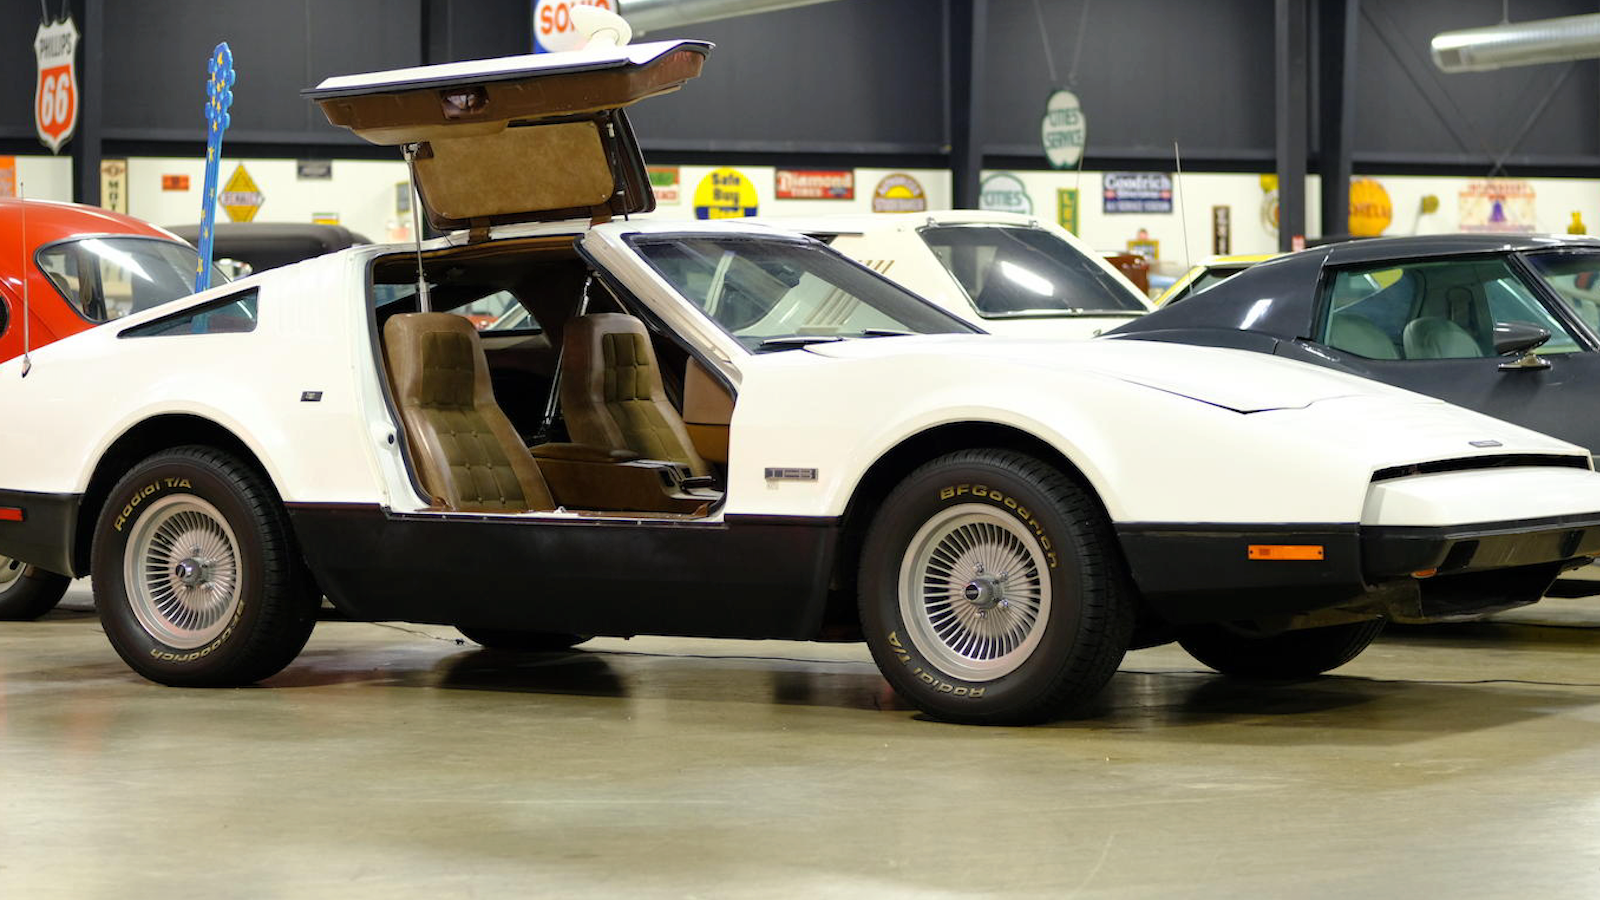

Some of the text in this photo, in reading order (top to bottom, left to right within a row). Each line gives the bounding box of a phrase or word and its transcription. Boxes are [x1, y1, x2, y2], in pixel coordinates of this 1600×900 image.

[40, 32, 72, 58] PHILLIPS
[42, 73, 69, 126] 66
[1049, 109, 1079, 127] CITIES
[1045, 129, 1085, 150] SERVICE
[712, 172, 740, 186] Safe
[779, 172, 852, 191] Diamond
[713, 188, 740, 208] Buy
[984, 191, 1023, 207] CITIES
[113, 477, 193, 532] Radial T/A
[939, 484, 1059, 569] BFGoodrich
[886, 630, 986, 699] Radial T/A
